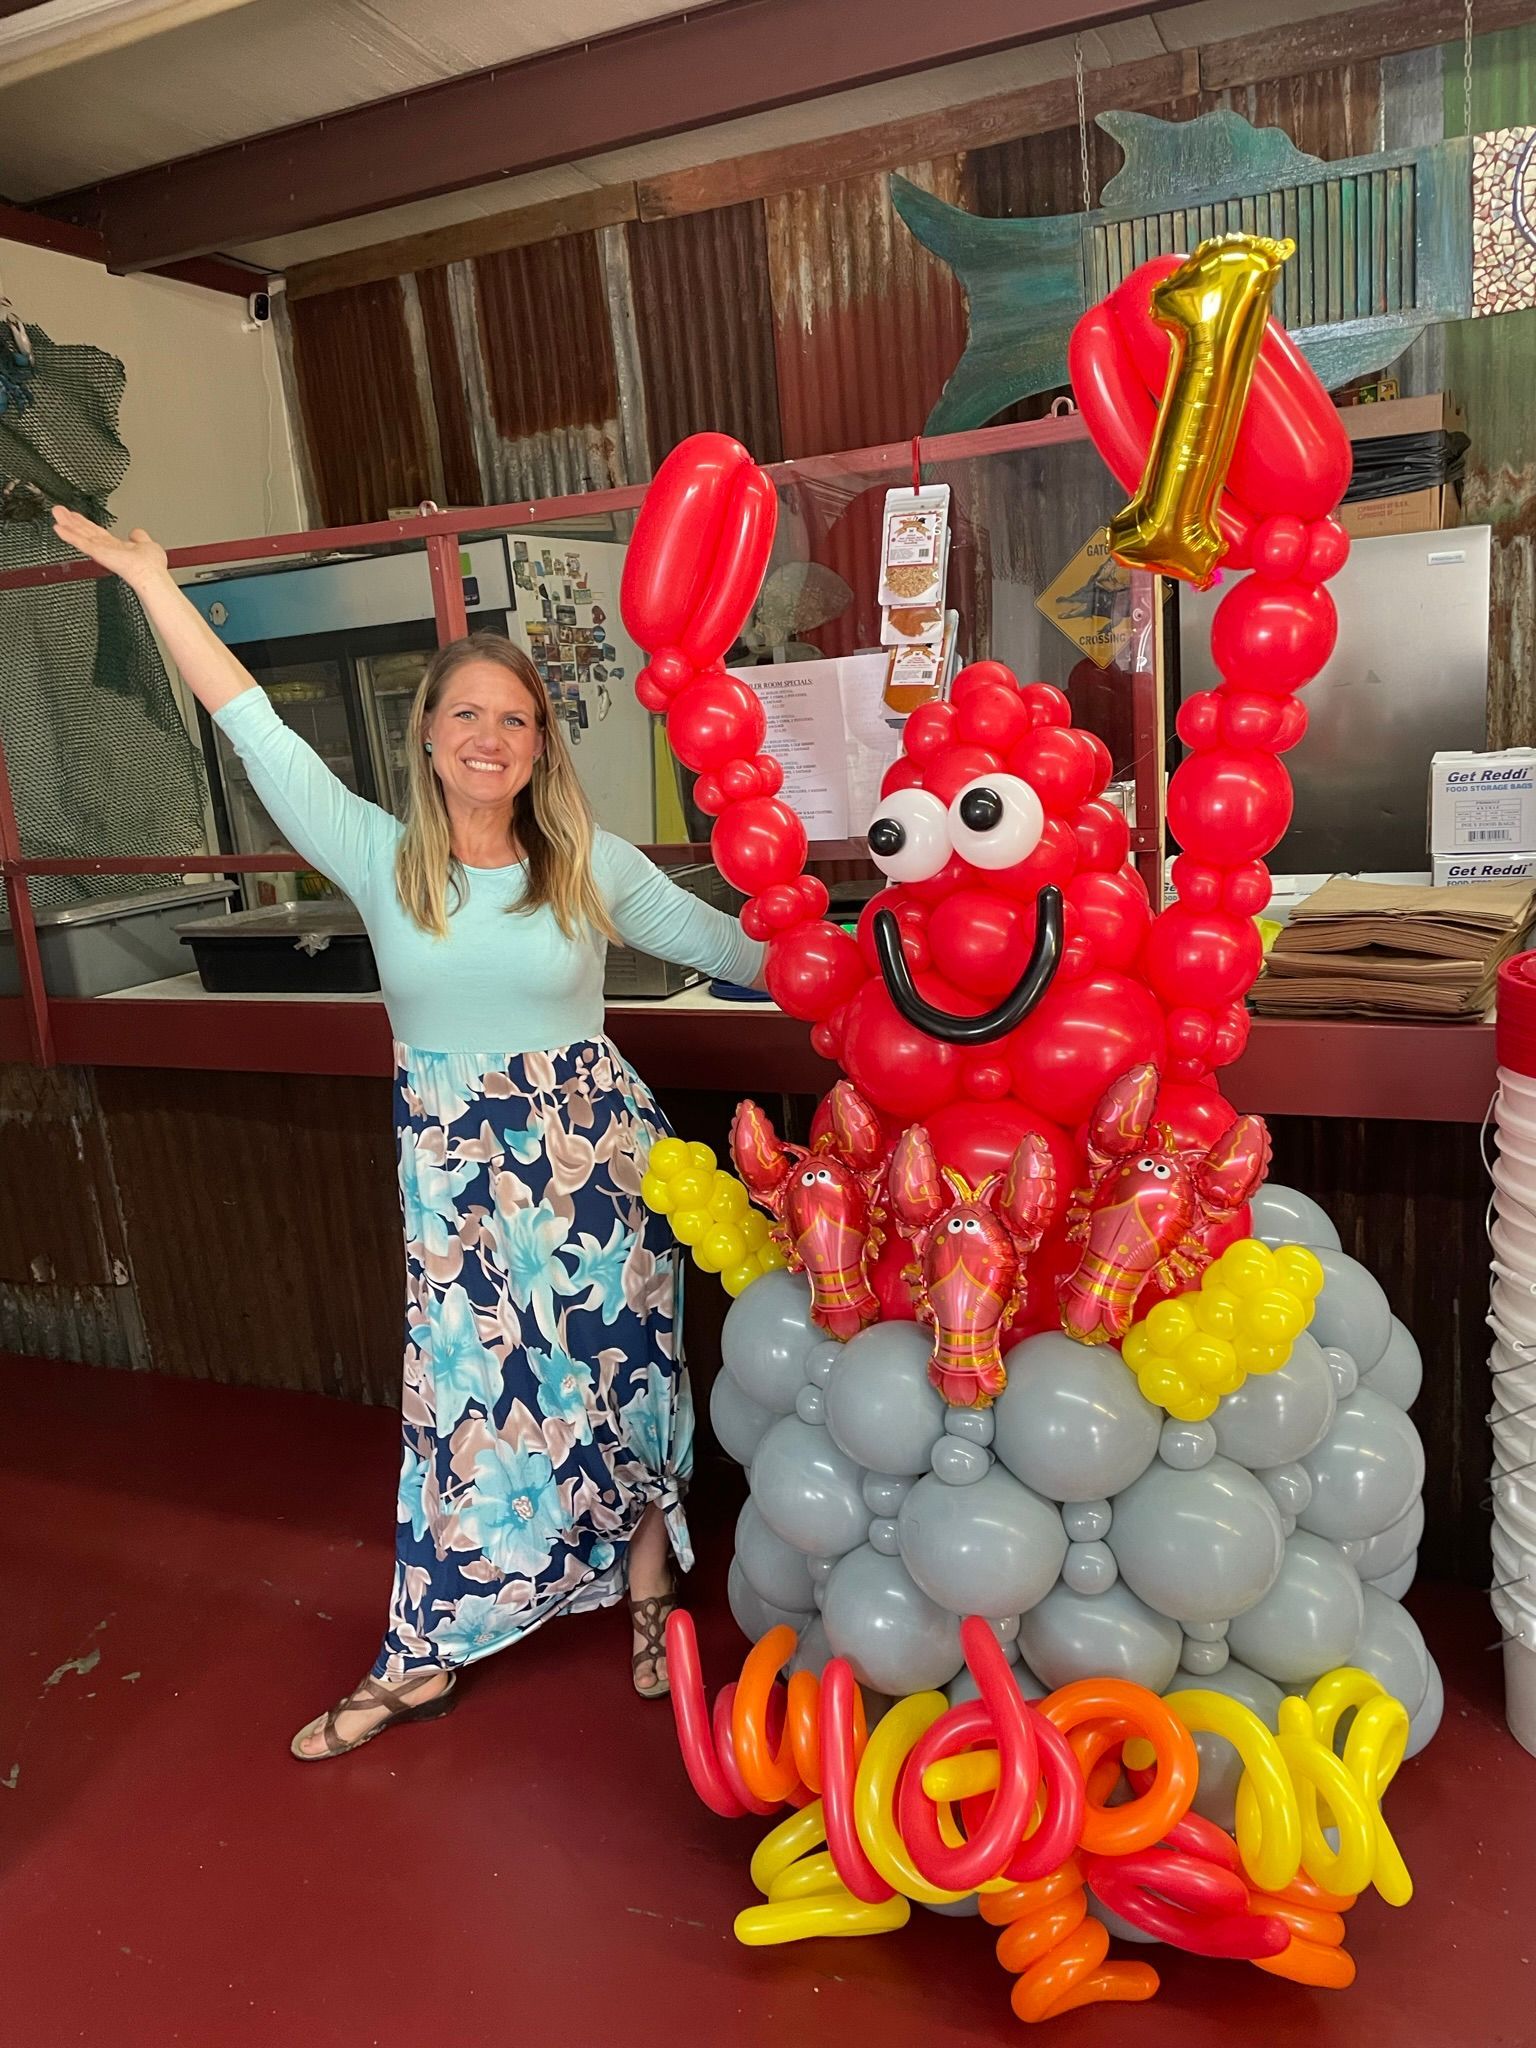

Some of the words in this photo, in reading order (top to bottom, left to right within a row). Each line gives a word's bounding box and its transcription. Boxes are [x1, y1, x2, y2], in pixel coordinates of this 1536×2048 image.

[1108, 232, 1296, 587] 1
[1087, 544, 1110, 556] GATO
[1079, 633, 1126, 646] CROSSING
[763, 680, 783, 689] ROOM
[1448, 771, 1477, 782] Get
[1481, 768, 1529, 781] Reddi
[1470, 784, 1508, 792] STORAGE
[1448, 866, 1477, 876] Get
[1481, 864, 1528, 875] Reddi
